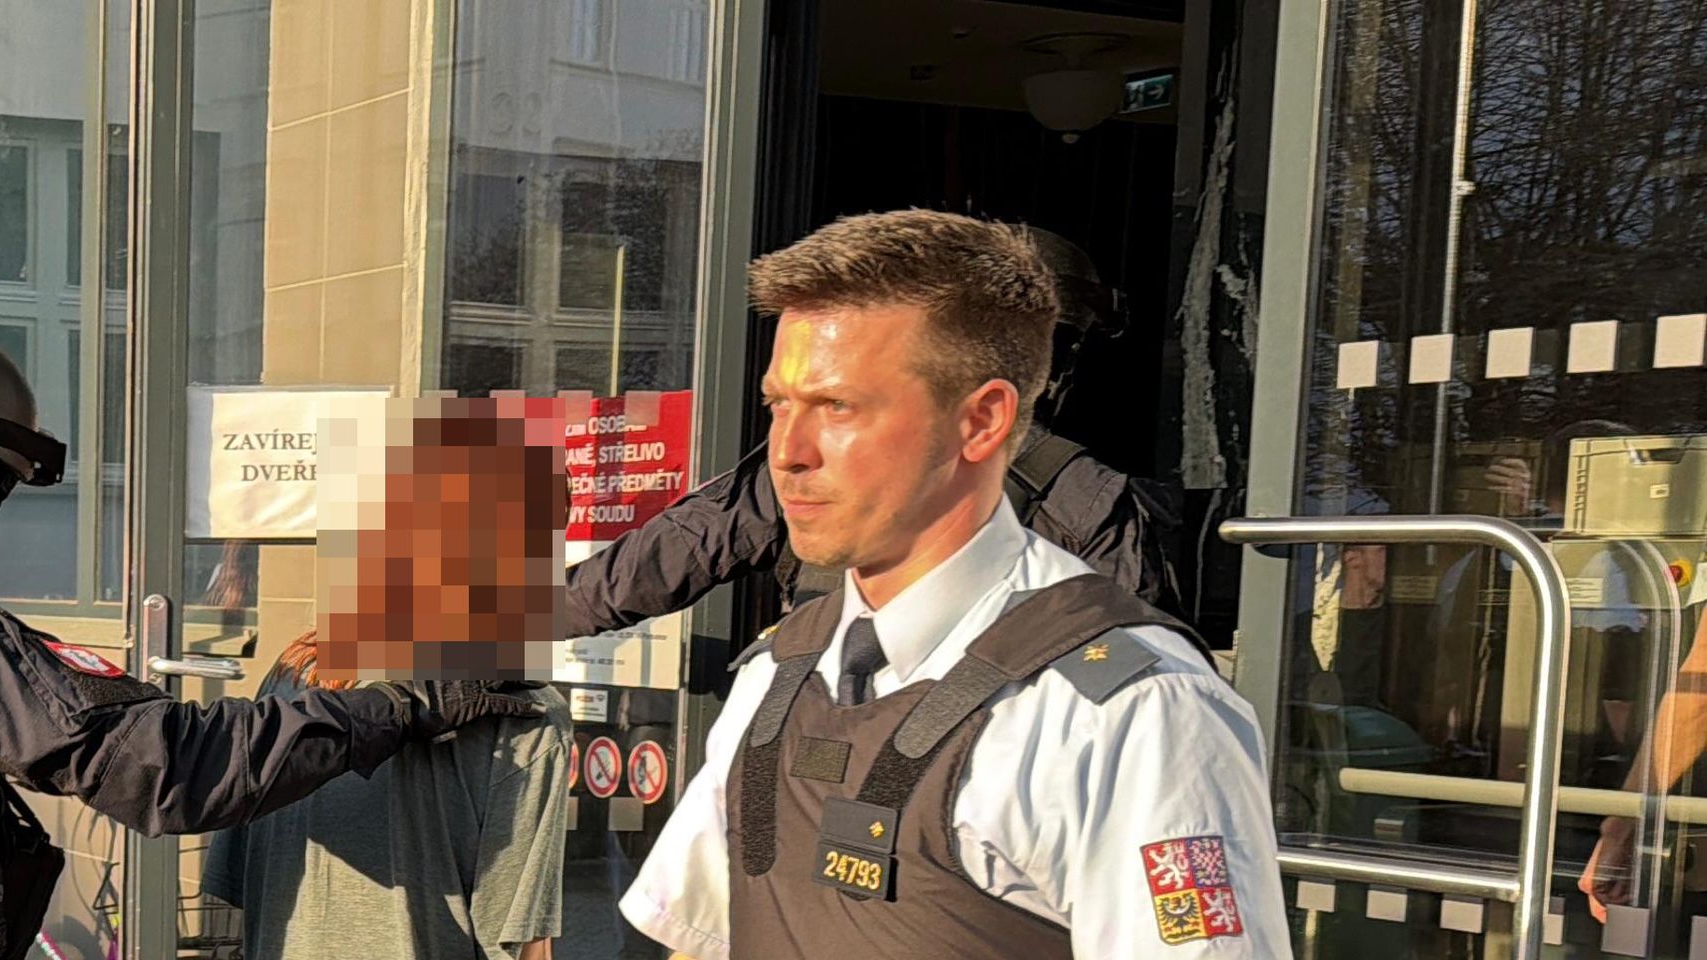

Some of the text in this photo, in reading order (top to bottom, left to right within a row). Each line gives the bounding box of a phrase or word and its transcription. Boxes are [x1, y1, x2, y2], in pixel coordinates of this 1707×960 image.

[598, 441, 665, 463] STŘELIVO
[607, 469, 685, 492] PŘEDMĚTY
[588, 504, 635, 522] SOUDU
[823, 851, 881, 890] 24793
